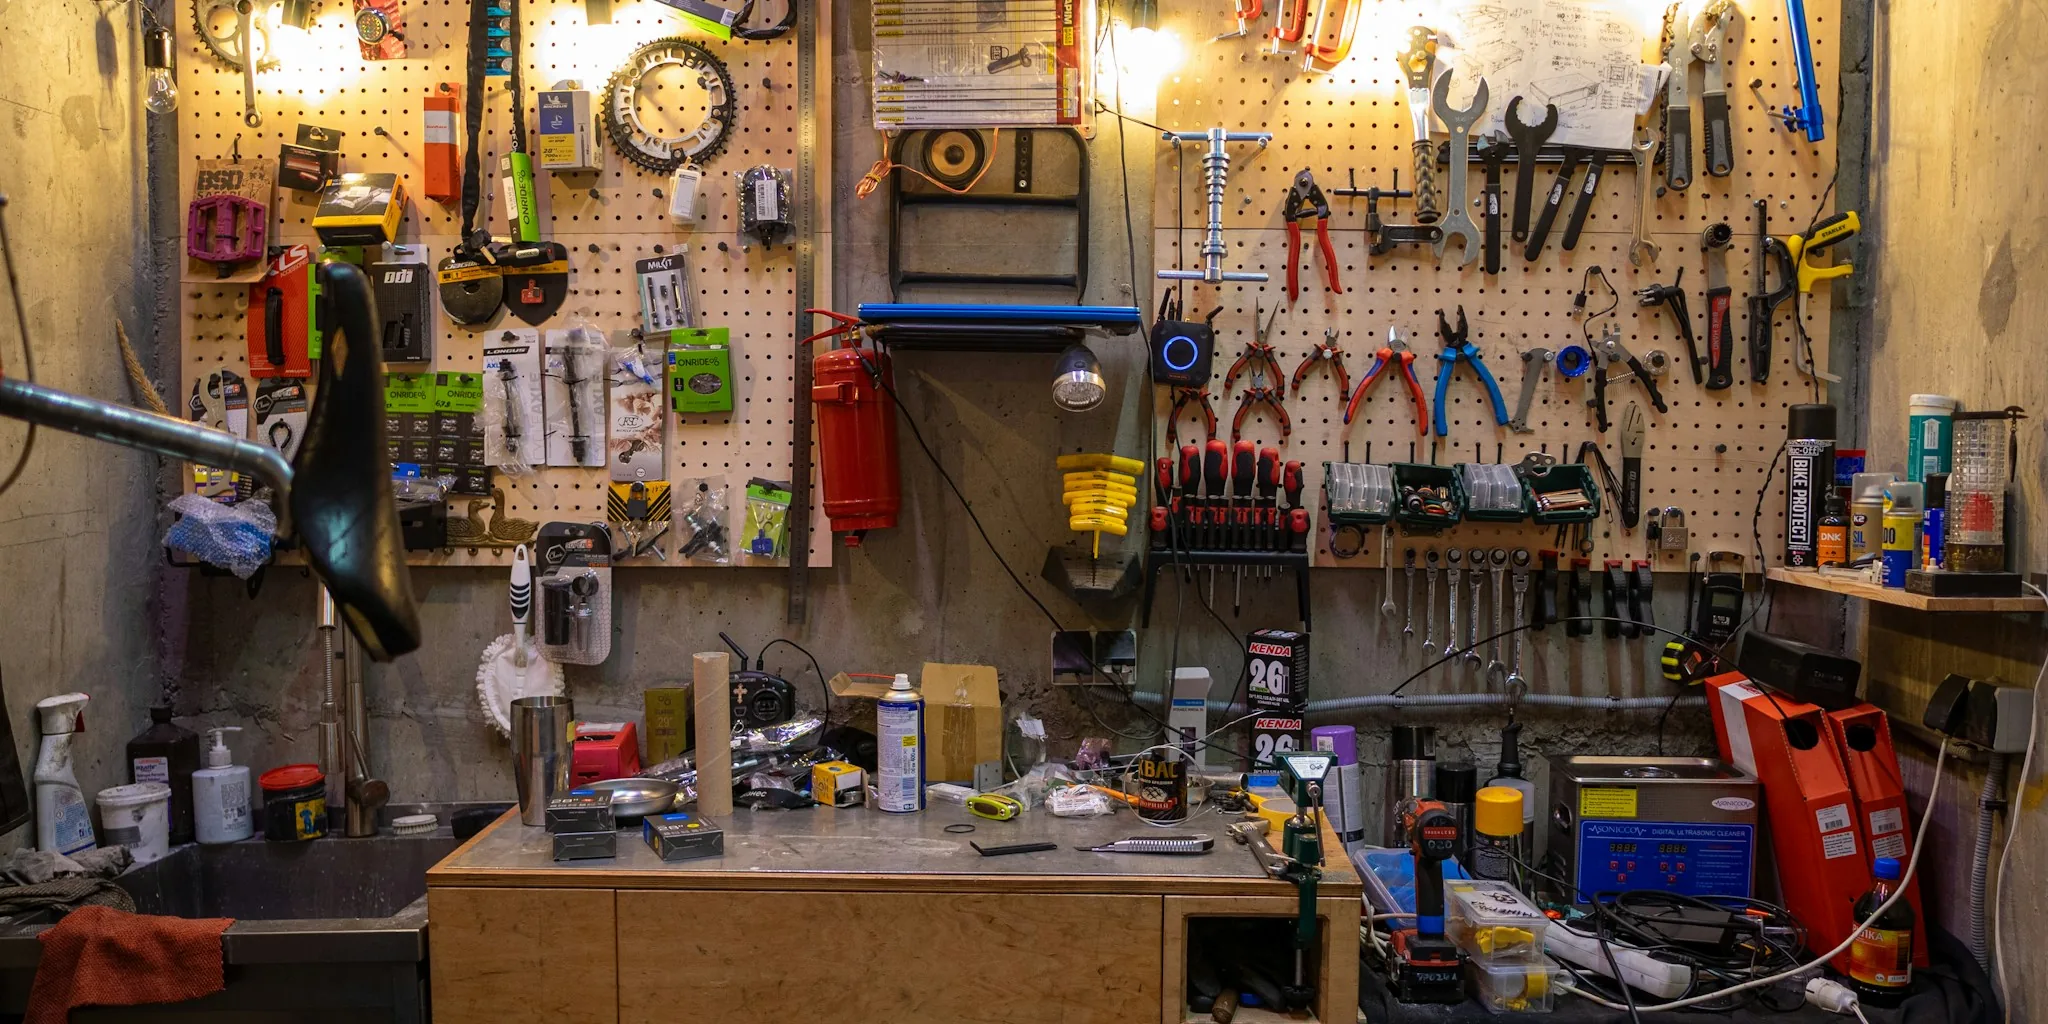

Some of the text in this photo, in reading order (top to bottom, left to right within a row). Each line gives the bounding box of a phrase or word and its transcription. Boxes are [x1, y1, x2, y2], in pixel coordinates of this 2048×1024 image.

[1064, 0, 1073, 25] APIM
[197, 170, 245, 191] BSD
[522, 182, 530, 225] ONRIDE
[1822, 224, 1846, 237] STANLEY
[647, 257, 673, 270] MILKIT
[677, 358, 712, 369] ONRIDE
[390, 391, 418, 399] ONRIDE
[447, 390, 476, 399] ONRIDE
[1791, 459, 1809, 542] BIKE PROTECT
[1853, 515, 1866, 524] K2
[1821, 533, 1842, 542] DNK
[1853, 530, 1866, 543] SIL
[1249, 643, 1292, 657] KENDA
[1250, 658, 1284, 696] 26
[1255, 718, 1302, 730] KENDA
